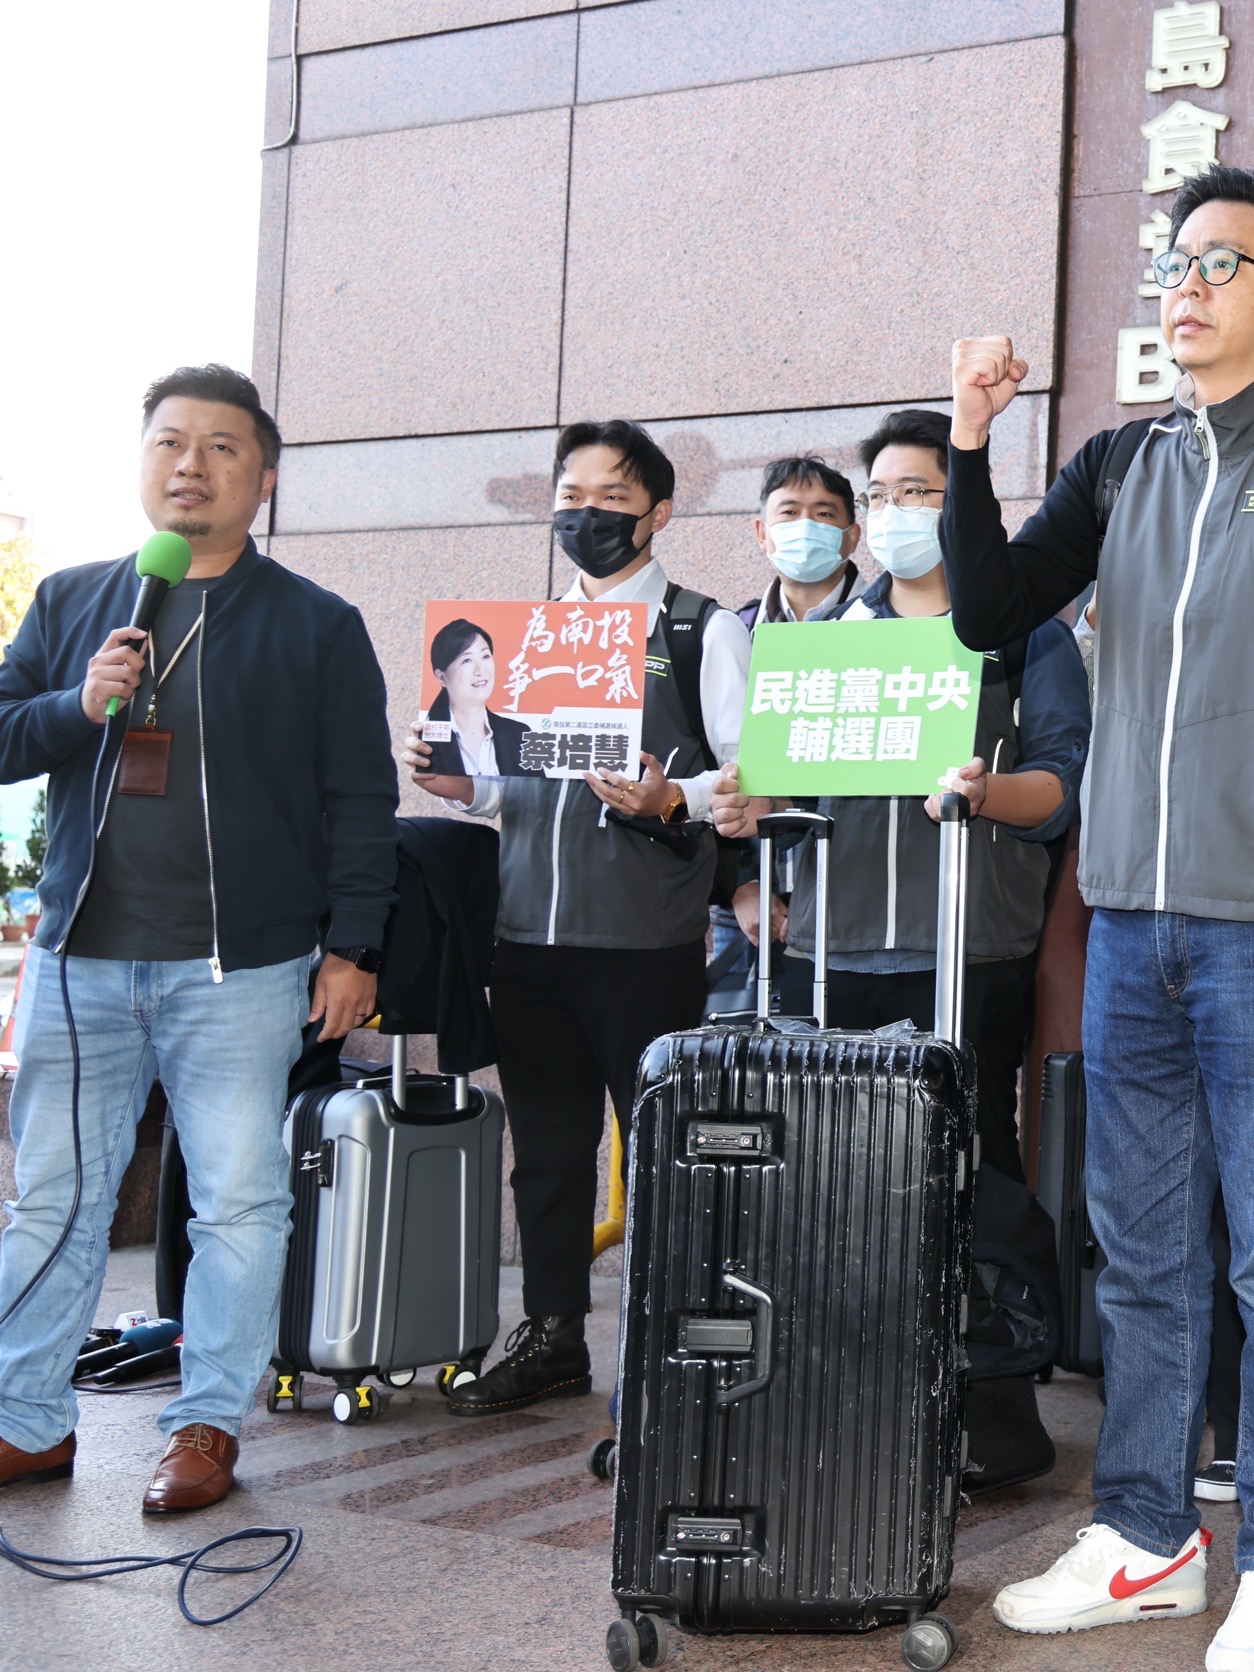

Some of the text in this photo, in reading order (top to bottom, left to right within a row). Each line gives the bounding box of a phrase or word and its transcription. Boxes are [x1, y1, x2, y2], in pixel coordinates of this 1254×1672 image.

[522, 604, 635, 654] 為南投
[502, 648, 639, 713] 爭一口氣
[644, 660, 666, 670] PP
[750, 664, 972, 715] 民進黨中央
[518, 731, 630, 773] 蔡培慧
[785, 715, 922, 763] 輔選團
